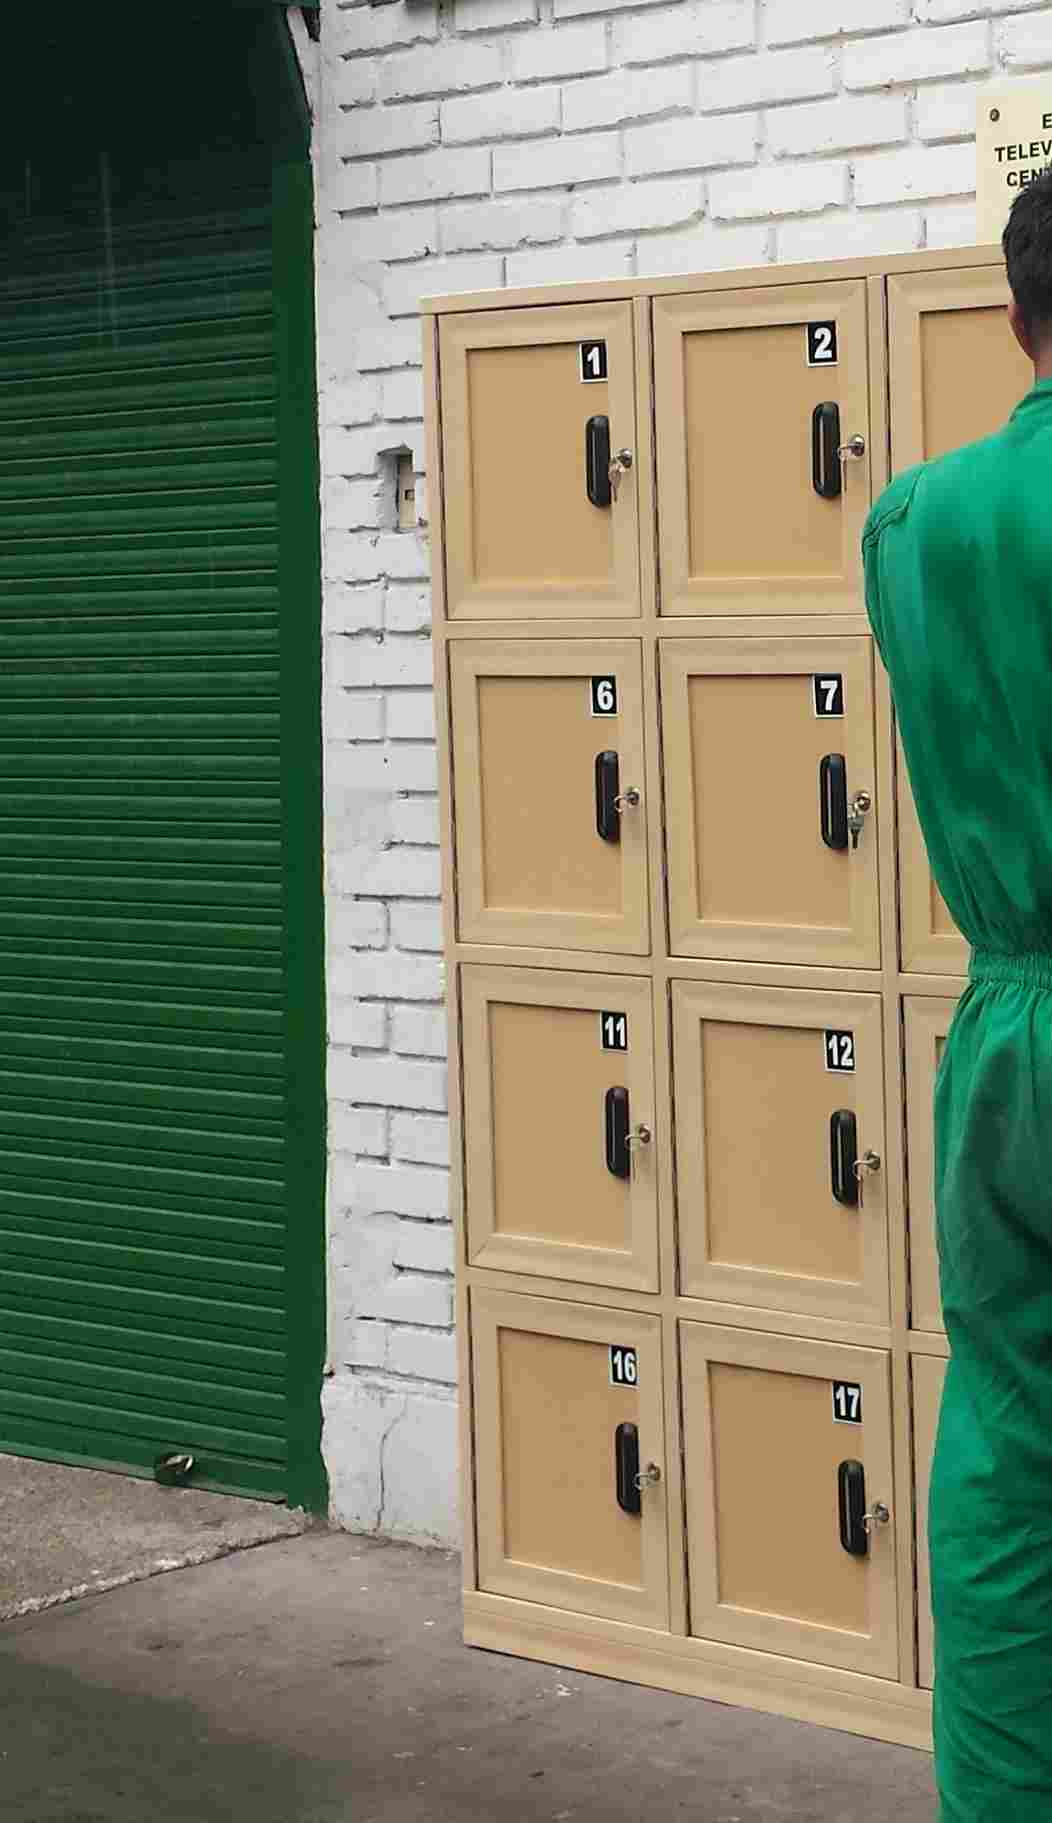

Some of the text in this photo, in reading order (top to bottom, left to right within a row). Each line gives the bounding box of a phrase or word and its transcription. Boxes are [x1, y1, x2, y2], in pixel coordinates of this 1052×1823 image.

[1006, 168, 1043, 188] CEN
[814, 327, 833, 359] 2
[587, 346, 600, 376] 1
[596, 680, 614, 711] 6
[820, 680, 838, 711] 7
[604, 1015, 626, 1047] 11
[828, 1034, 854, 1067] 12
[613, 1350, 637, 1382] 16
[835, 1385, 861, 1418] 17
